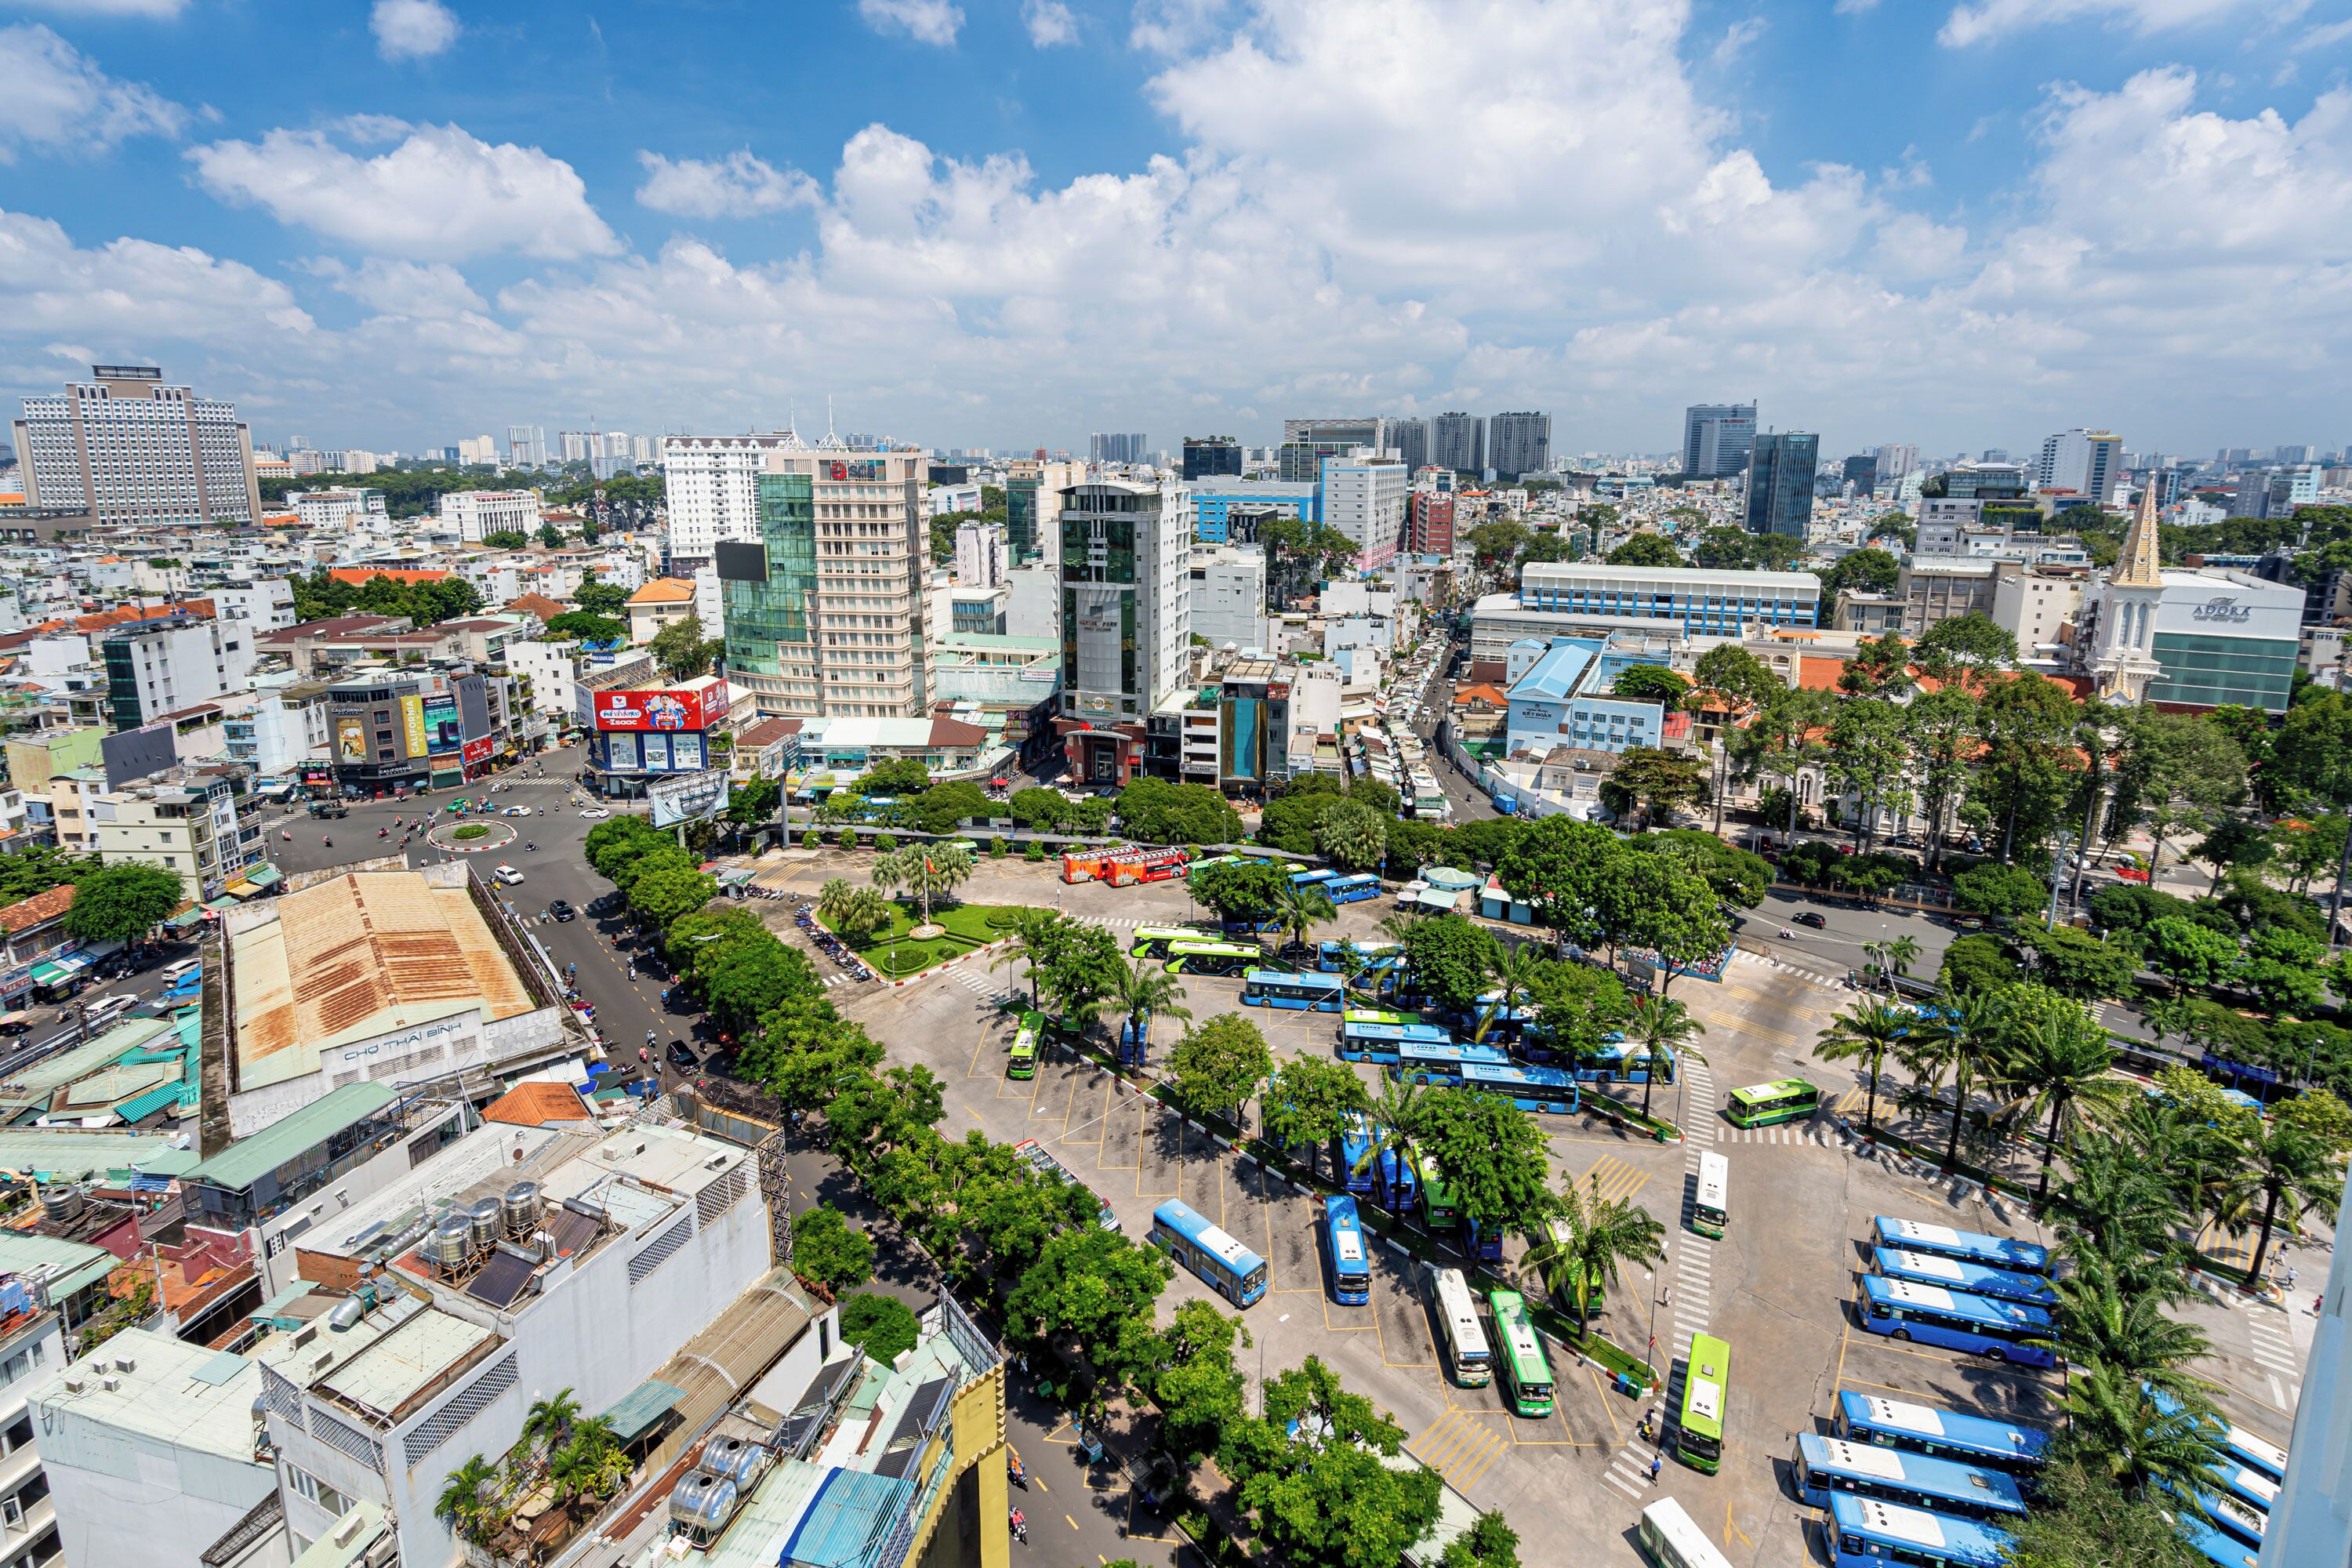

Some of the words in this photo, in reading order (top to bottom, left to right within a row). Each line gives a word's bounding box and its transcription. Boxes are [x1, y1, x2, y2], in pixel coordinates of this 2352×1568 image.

[848, 465, 875, 477] SCB
[406, 700, 419, 753] CALIFORNIA
[379, 765, 412, 774] CALIFORNIA
[344, 1044, 379, 1060] CHỢ
[383, 1031, 423, 1049] THÁI
